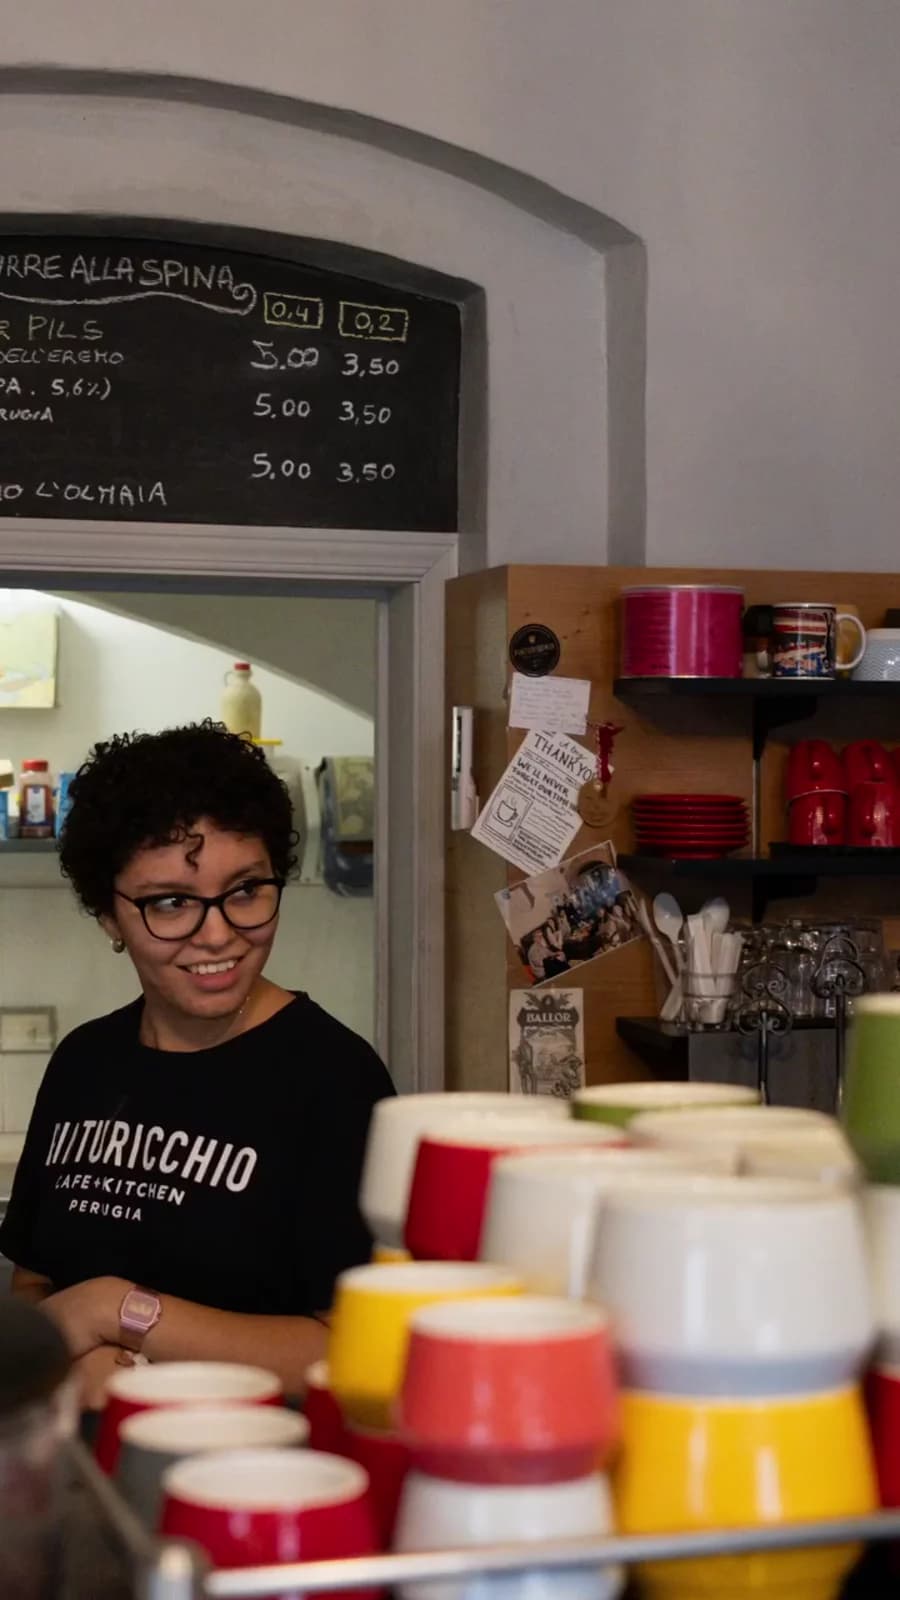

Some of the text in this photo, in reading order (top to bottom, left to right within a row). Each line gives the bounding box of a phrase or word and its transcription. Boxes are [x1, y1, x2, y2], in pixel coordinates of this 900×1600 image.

[70, 254, 135, 284] ALLA
[139, 259, 234, 291] SPINA
[28, 314, 104, 341] PILS
[271, 301, 396, 334] 0,4 0,2
[341, 353, 400, 377] 3,50
[51, 377, 112, 400] 5,6%)
[253, 393, 391, 426] 5.00 3,50
[250, 453, 311, 480] 5.00
[534, 732, 579, 773] THANK
[576, 762, 595, 782] YO
[542, 774, 569, 797] NEVER
[526, 1012, 572, 1023] BALLOR
[68, 1199, 142, 1222] PERUGIA
